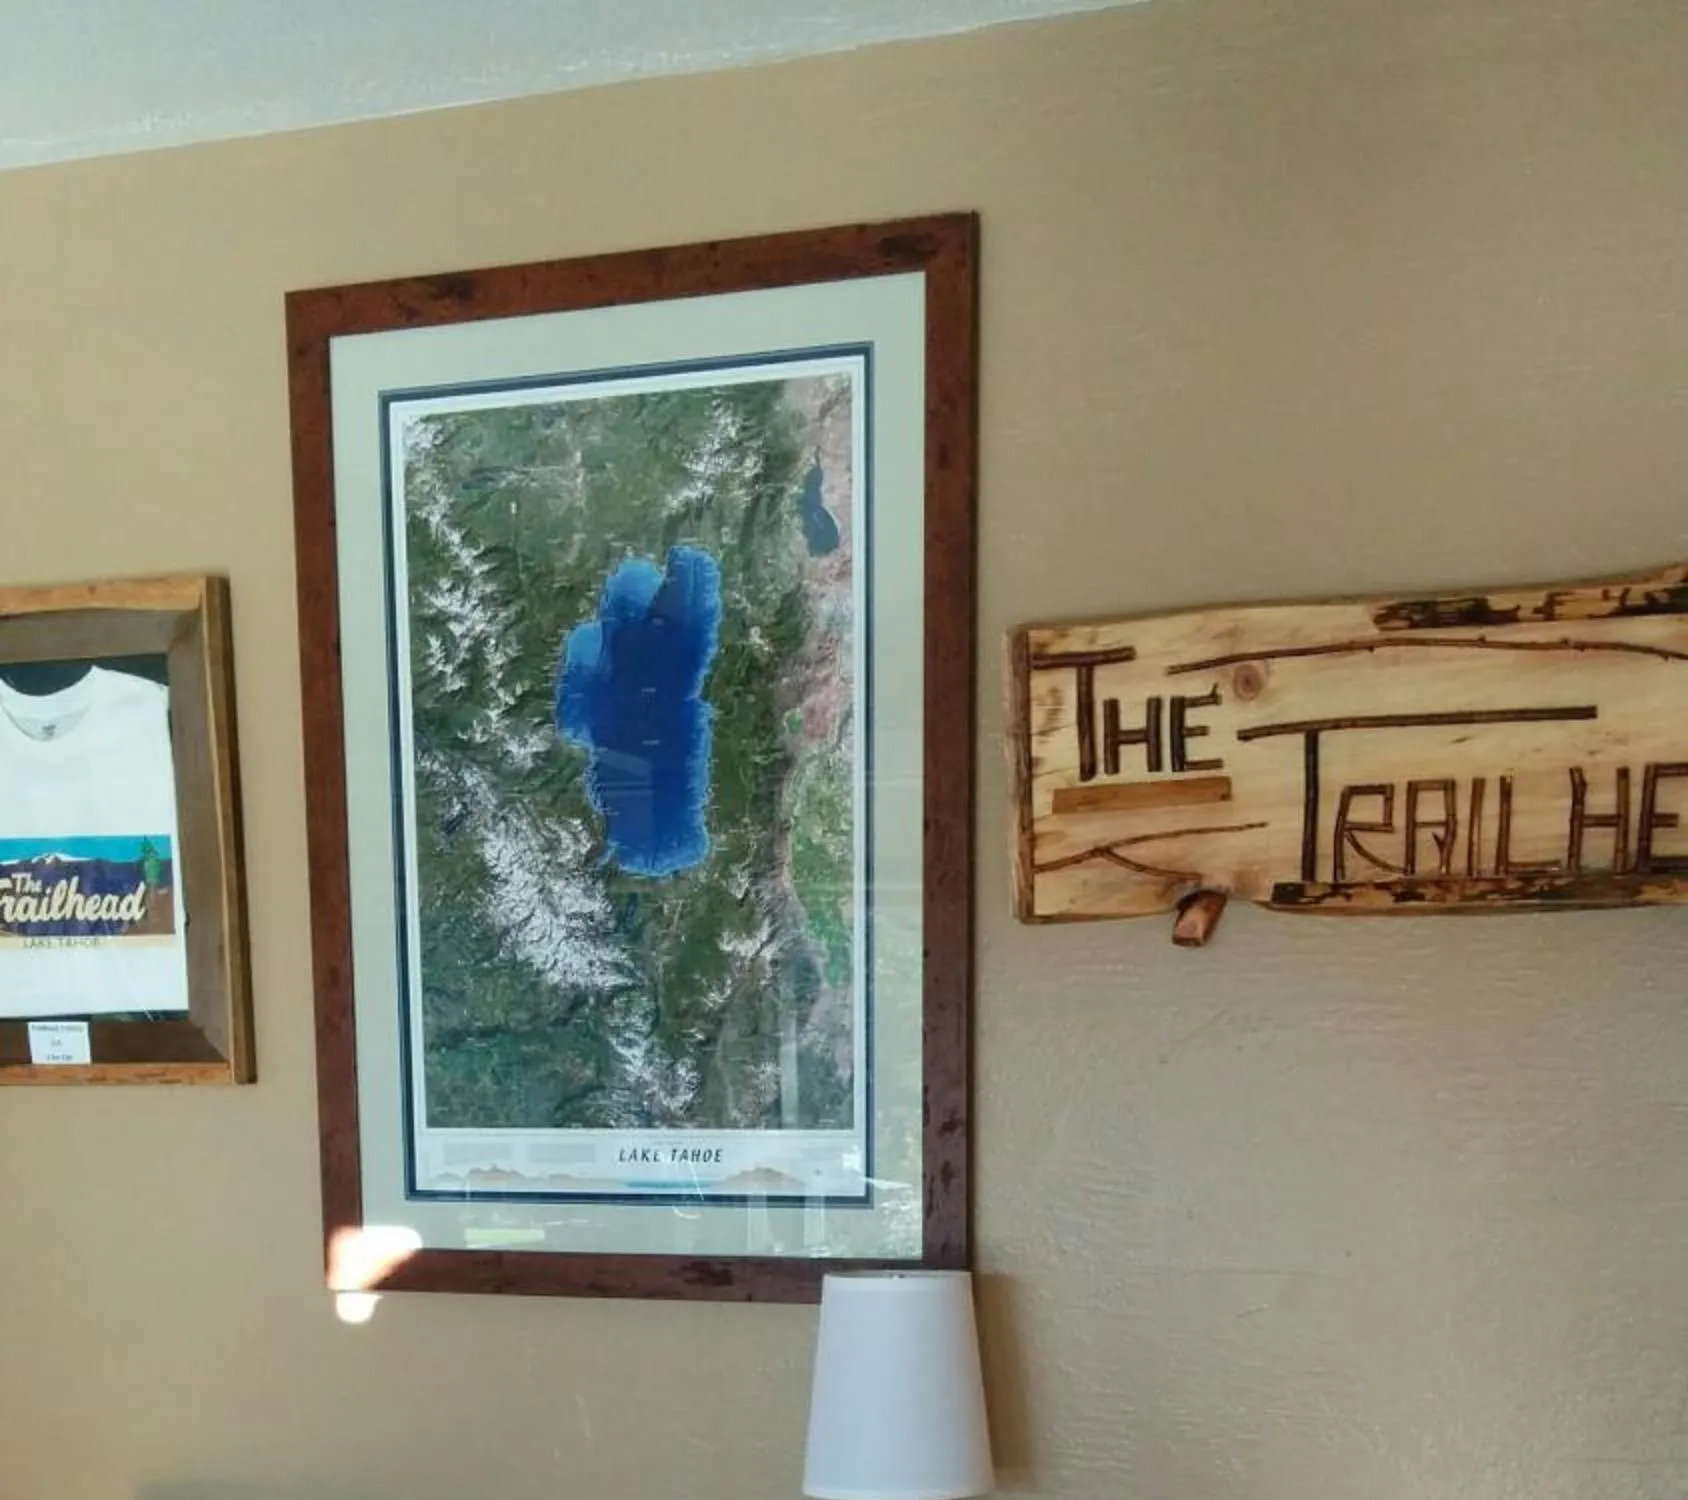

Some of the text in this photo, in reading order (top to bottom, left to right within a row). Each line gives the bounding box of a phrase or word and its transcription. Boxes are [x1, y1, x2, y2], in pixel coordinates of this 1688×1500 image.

[1033, 646, 1222, 782] THE
[11, 872, 42, 893] The
[619, 1147, 723, 1162] LAKE TAHOE
